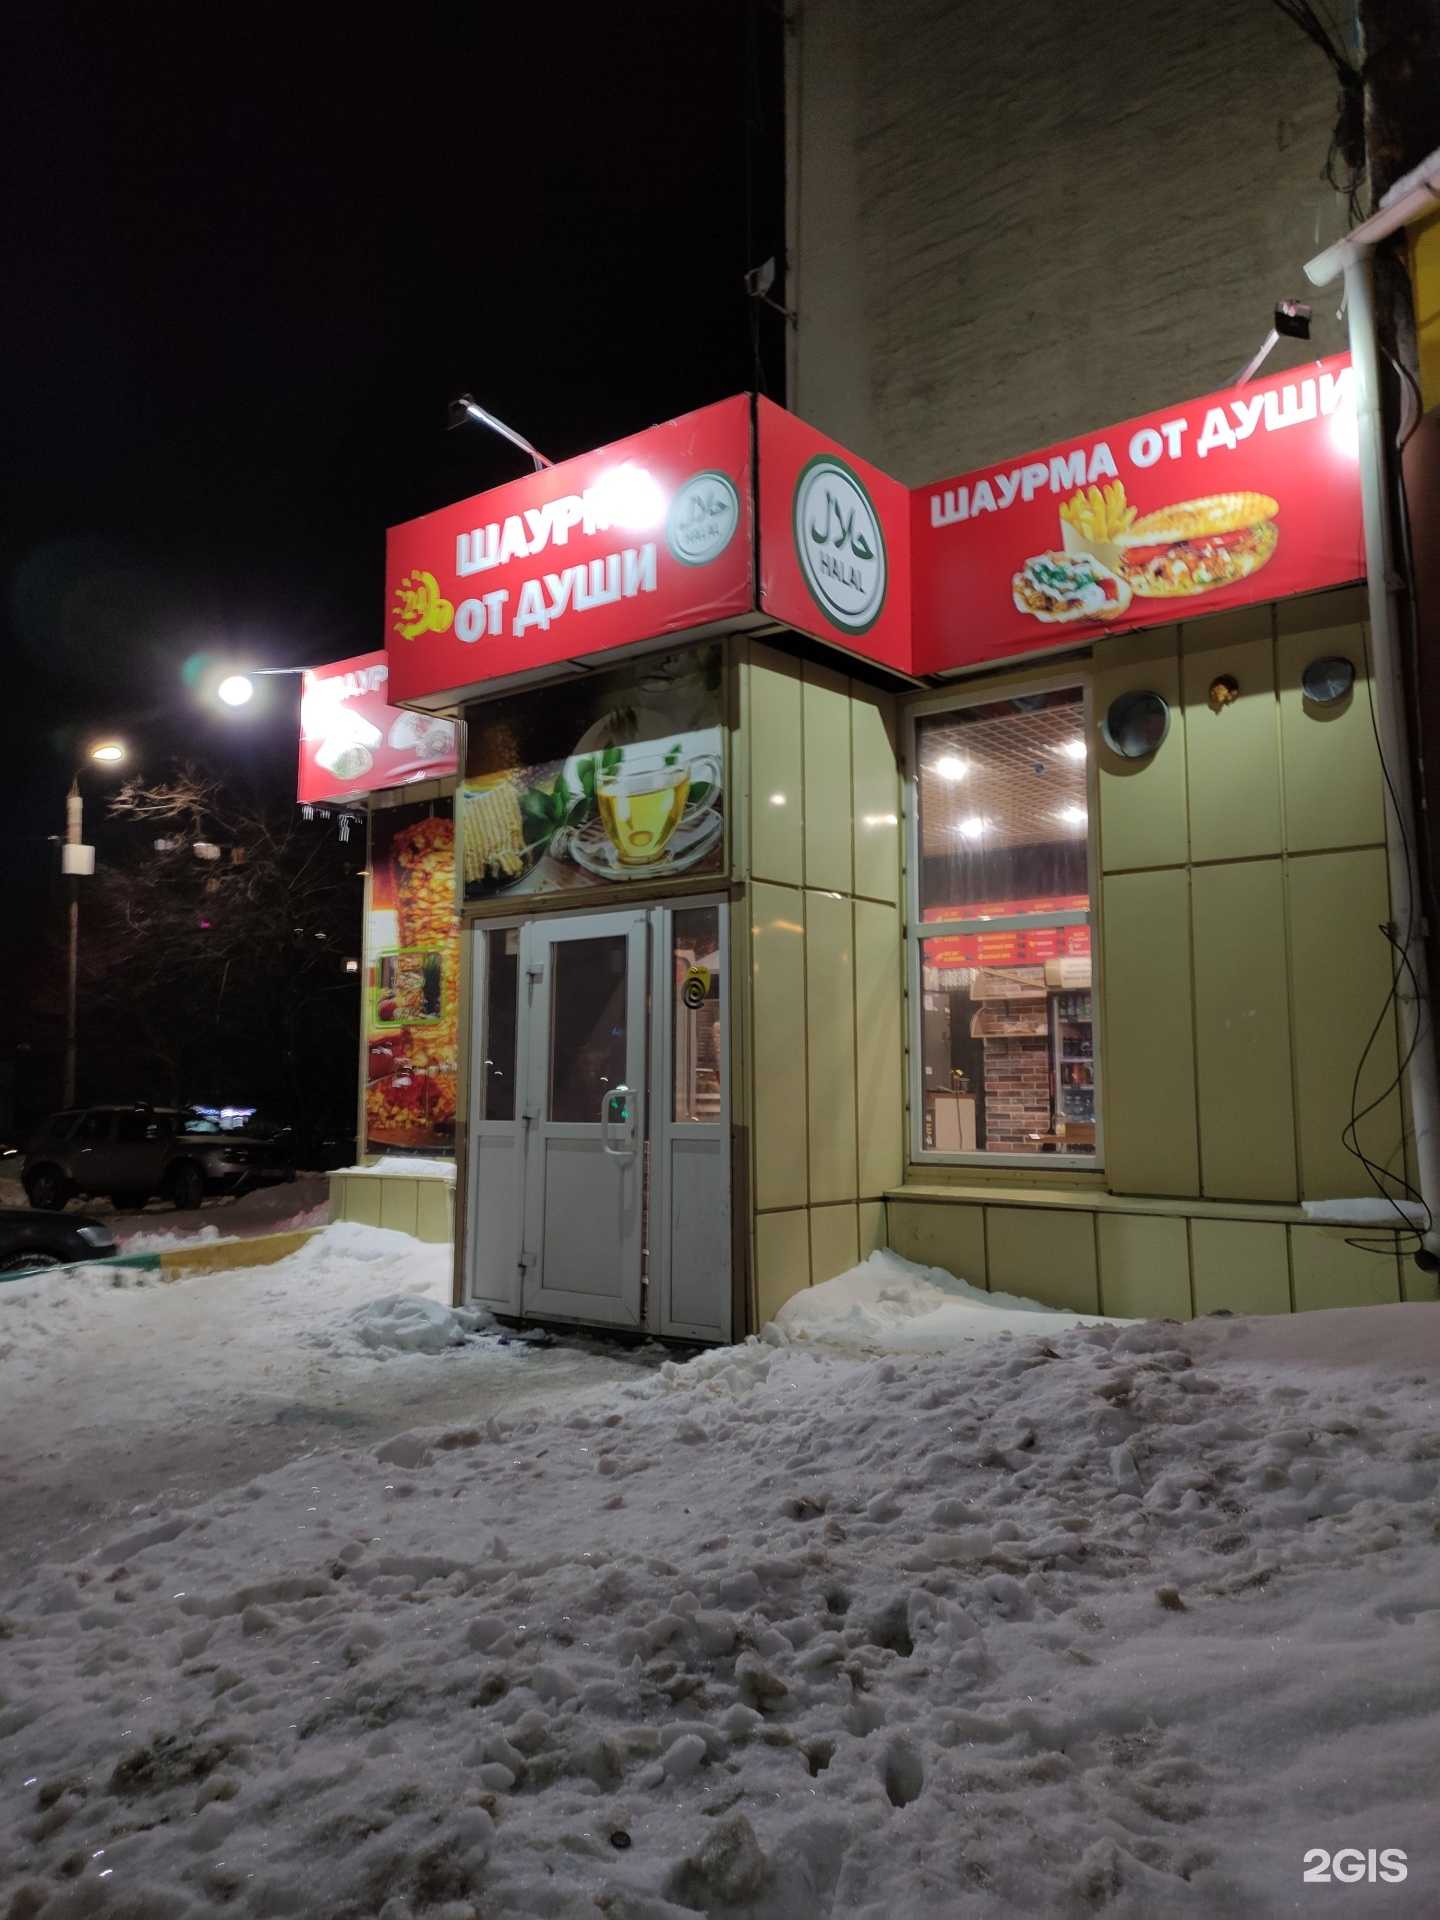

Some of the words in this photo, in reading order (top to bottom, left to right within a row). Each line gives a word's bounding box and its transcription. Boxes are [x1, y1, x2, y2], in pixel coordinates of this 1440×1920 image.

[931, 441, 1119, 528] ШАУРМА
[1128, 419, 1188, 468] ОТ
[1197, 367, 1358, 458] ДУШИ
[454, 589, 509, 643] ОТ
[512, 543, 657, 637] ДУШИ
[819, 550, 867, 594] HALAL
